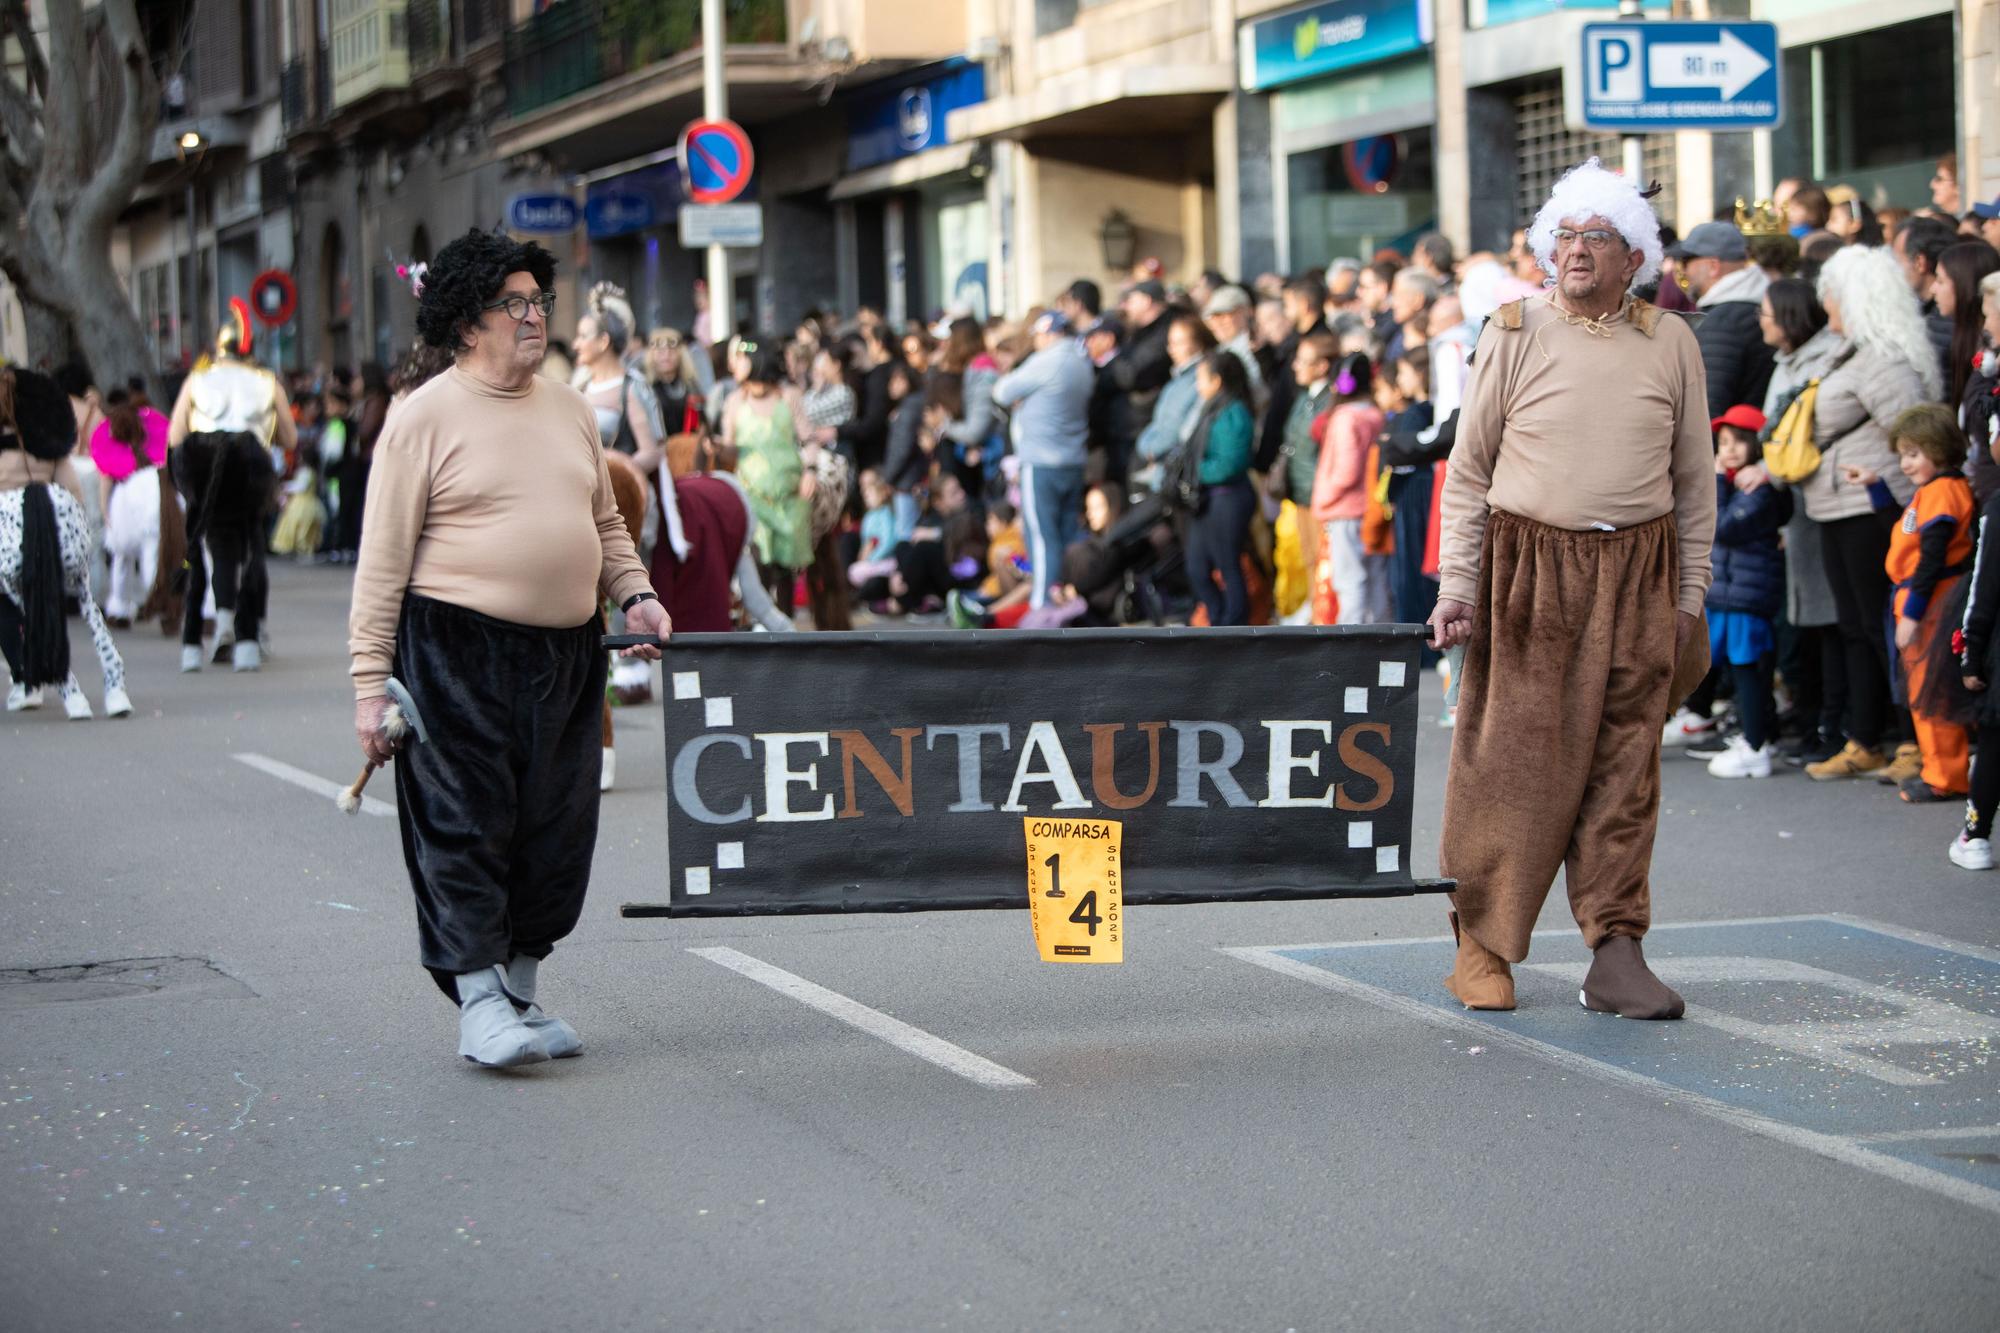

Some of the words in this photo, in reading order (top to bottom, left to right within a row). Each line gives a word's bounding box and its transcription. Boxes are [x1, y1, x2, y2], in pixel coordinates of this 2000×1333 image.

[1599, 38, 1630, 92] P
[1683, 56, 1704, 76] 80
[672, 720, 1392, 824] CENTAURES
[1032, 822, 1110, 839] COMPARSA
[1044, 853, 1066, 898] 1
[1068, 890, 1103, 936] 4
[1108, 902, 1118, 942] 2023
